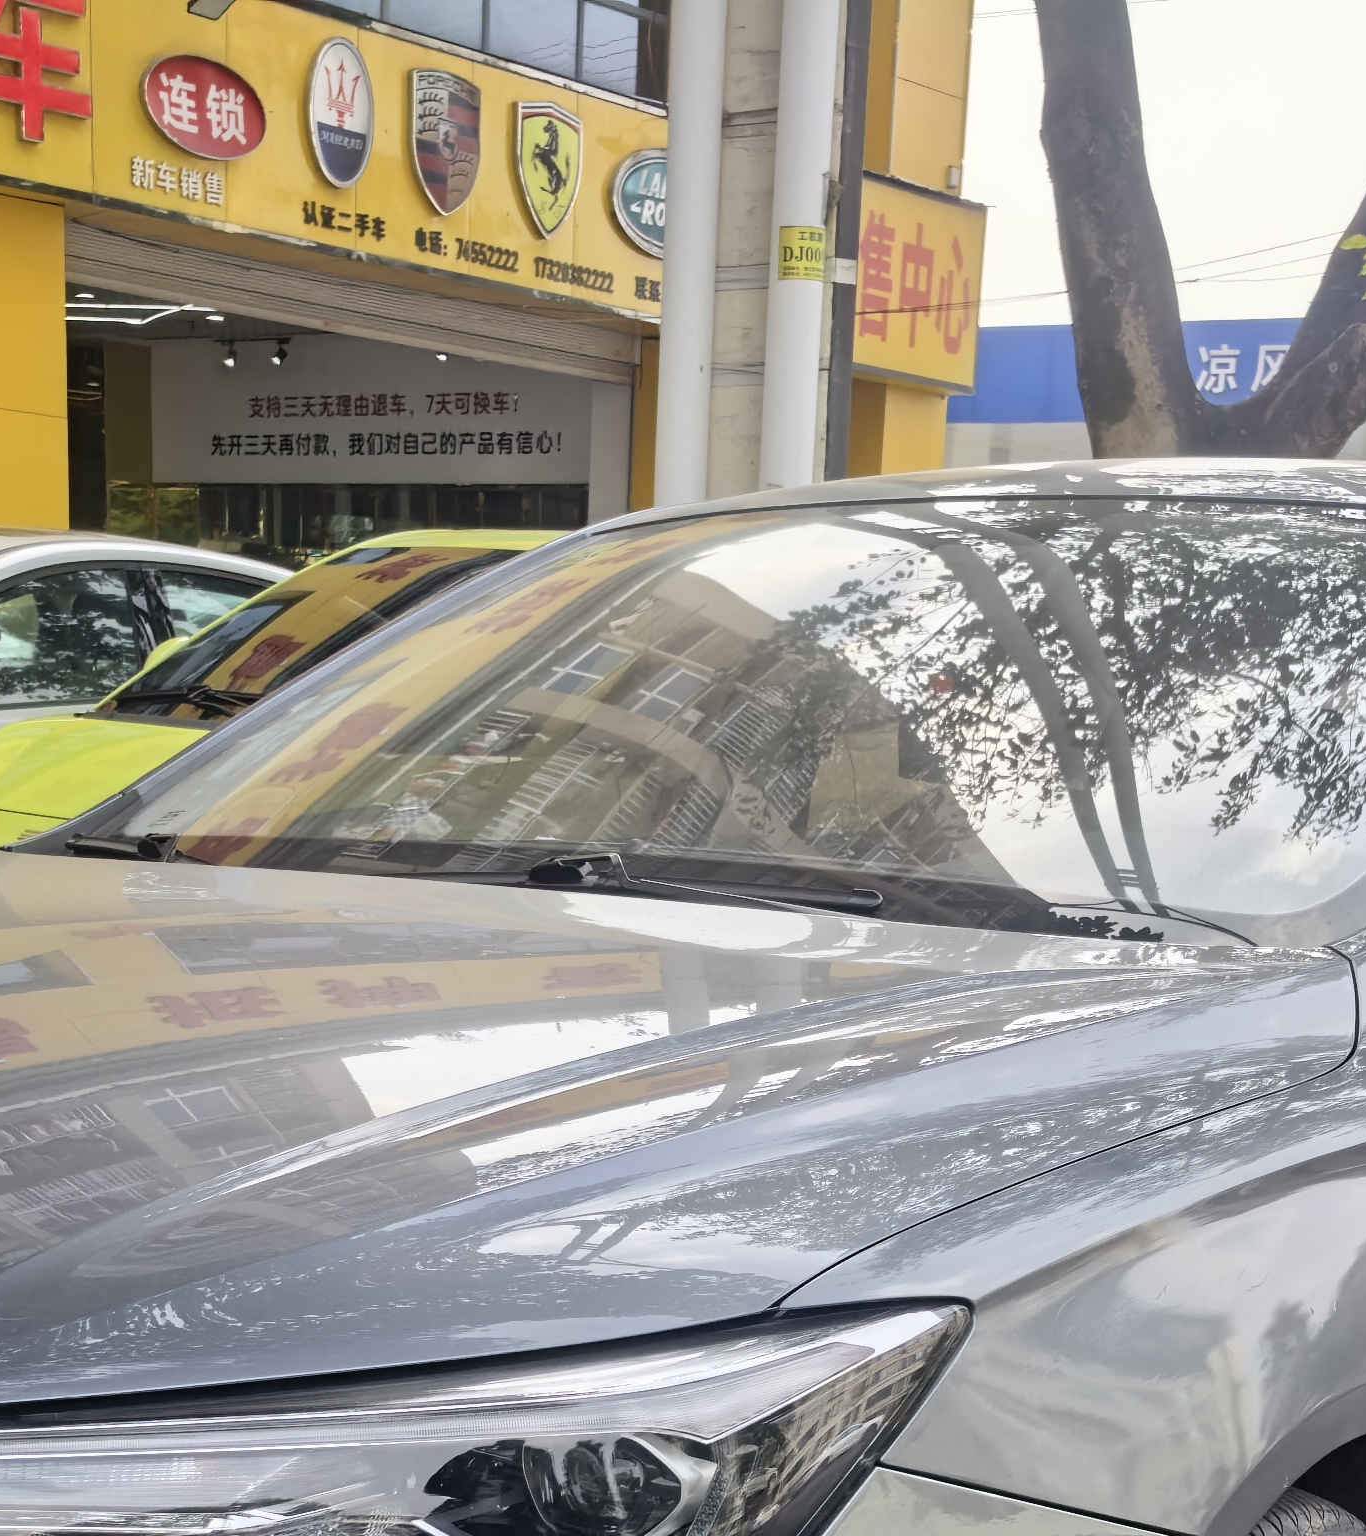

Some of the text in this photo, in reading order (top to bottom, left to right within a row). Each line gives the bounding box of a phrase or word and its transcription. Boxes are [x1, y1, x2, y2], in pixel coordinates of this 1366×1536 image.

[159, 73, 247, 146] 连锁
[131, 156, 225, 207] 新车销售
[303, 200, 386, 241] 认证二手车
[858, 209, 970, 355] 售中心
